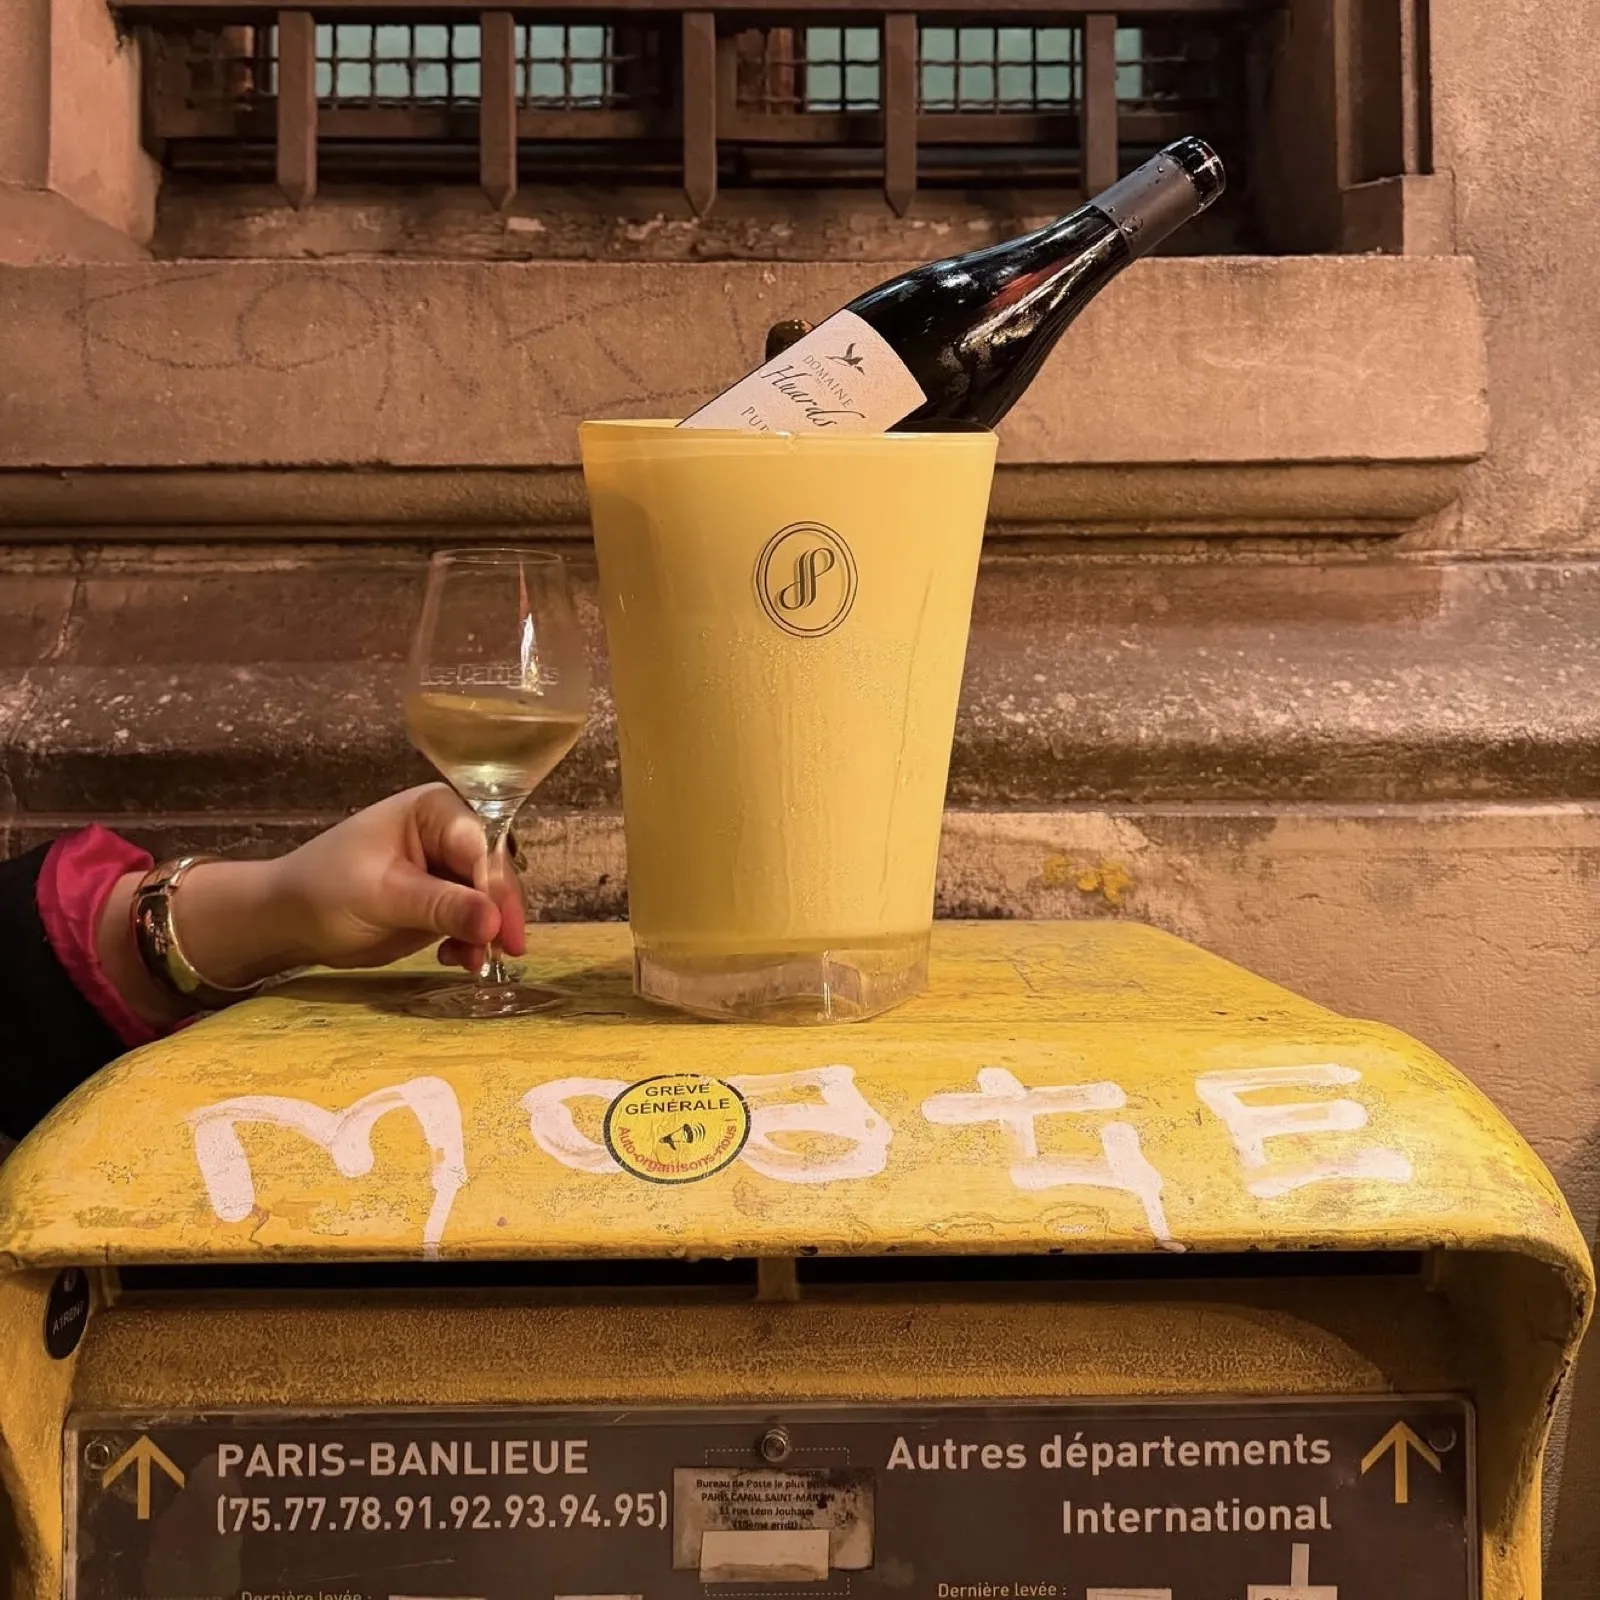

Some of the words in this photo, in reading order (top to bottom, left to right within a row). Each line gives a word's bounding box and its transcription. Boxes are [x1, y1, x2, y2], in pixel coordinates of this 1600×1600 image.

[759, 364, 866, 427] Huards
[802, 354, 854, 409] DOMAINE
[645, 1081, 710, 1097] GRÈVE
[625, 1097, 731, 1116] GÉNÉRALE
[217, 1439, 589, 1478] PARIS-BANLIEUE
[885, 1436, 1028, 1471] Autres
[1039, 1431, 1332, 1476] départements
[696, 1479, 730, 1489] Bureau
[731, 1479, 744, 1489] de
[746, 1479, 773, 1489] Poste
[774, 1479, 784, 1489] le
[785, 1479, 805, 1491] plus
[701, 1492, 729, 1502] PARIS
[730, 1492, 761, 1502] CANAL
[216, 1488, 668, 1535] (75.77.78.91.92.93.94.95)
[731, 1507, 749, 1516] rue
[750, 1506, 773, 1516] Léon
[1062, 1496, 1333, 1535] International
[937, 1581, 1010, 1598] Dernière
[1014, 1580, 1058, 1597] levée
